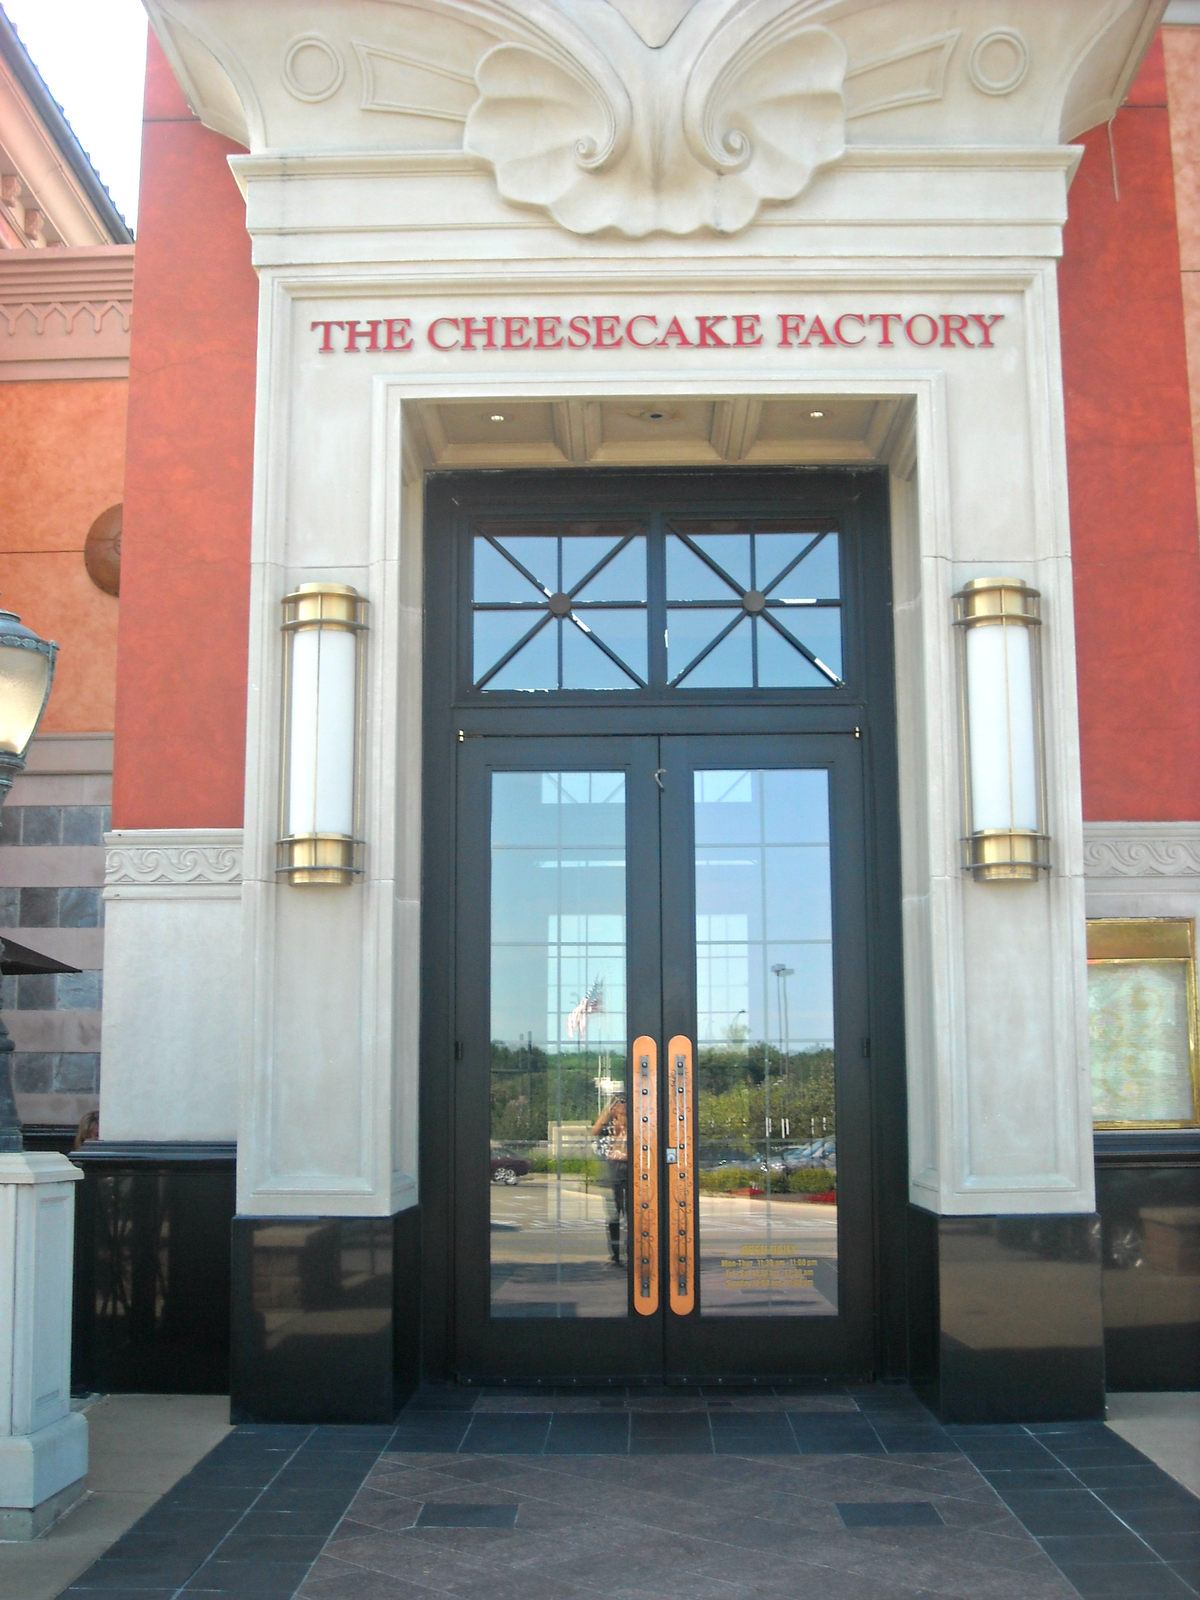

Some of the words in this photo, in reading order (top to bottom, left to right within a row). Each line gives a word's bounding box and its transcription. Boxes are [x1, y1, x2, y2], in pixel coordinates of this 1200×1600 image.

[310, 317, 414, 354] THE
[426, 314, 764, 351] CHEESECAKE
[777, 313, 1005, 348] FACTORY
[741, 1245, 768, 1256] OPEN
[770, 1244, 797, 1255] DAILY
